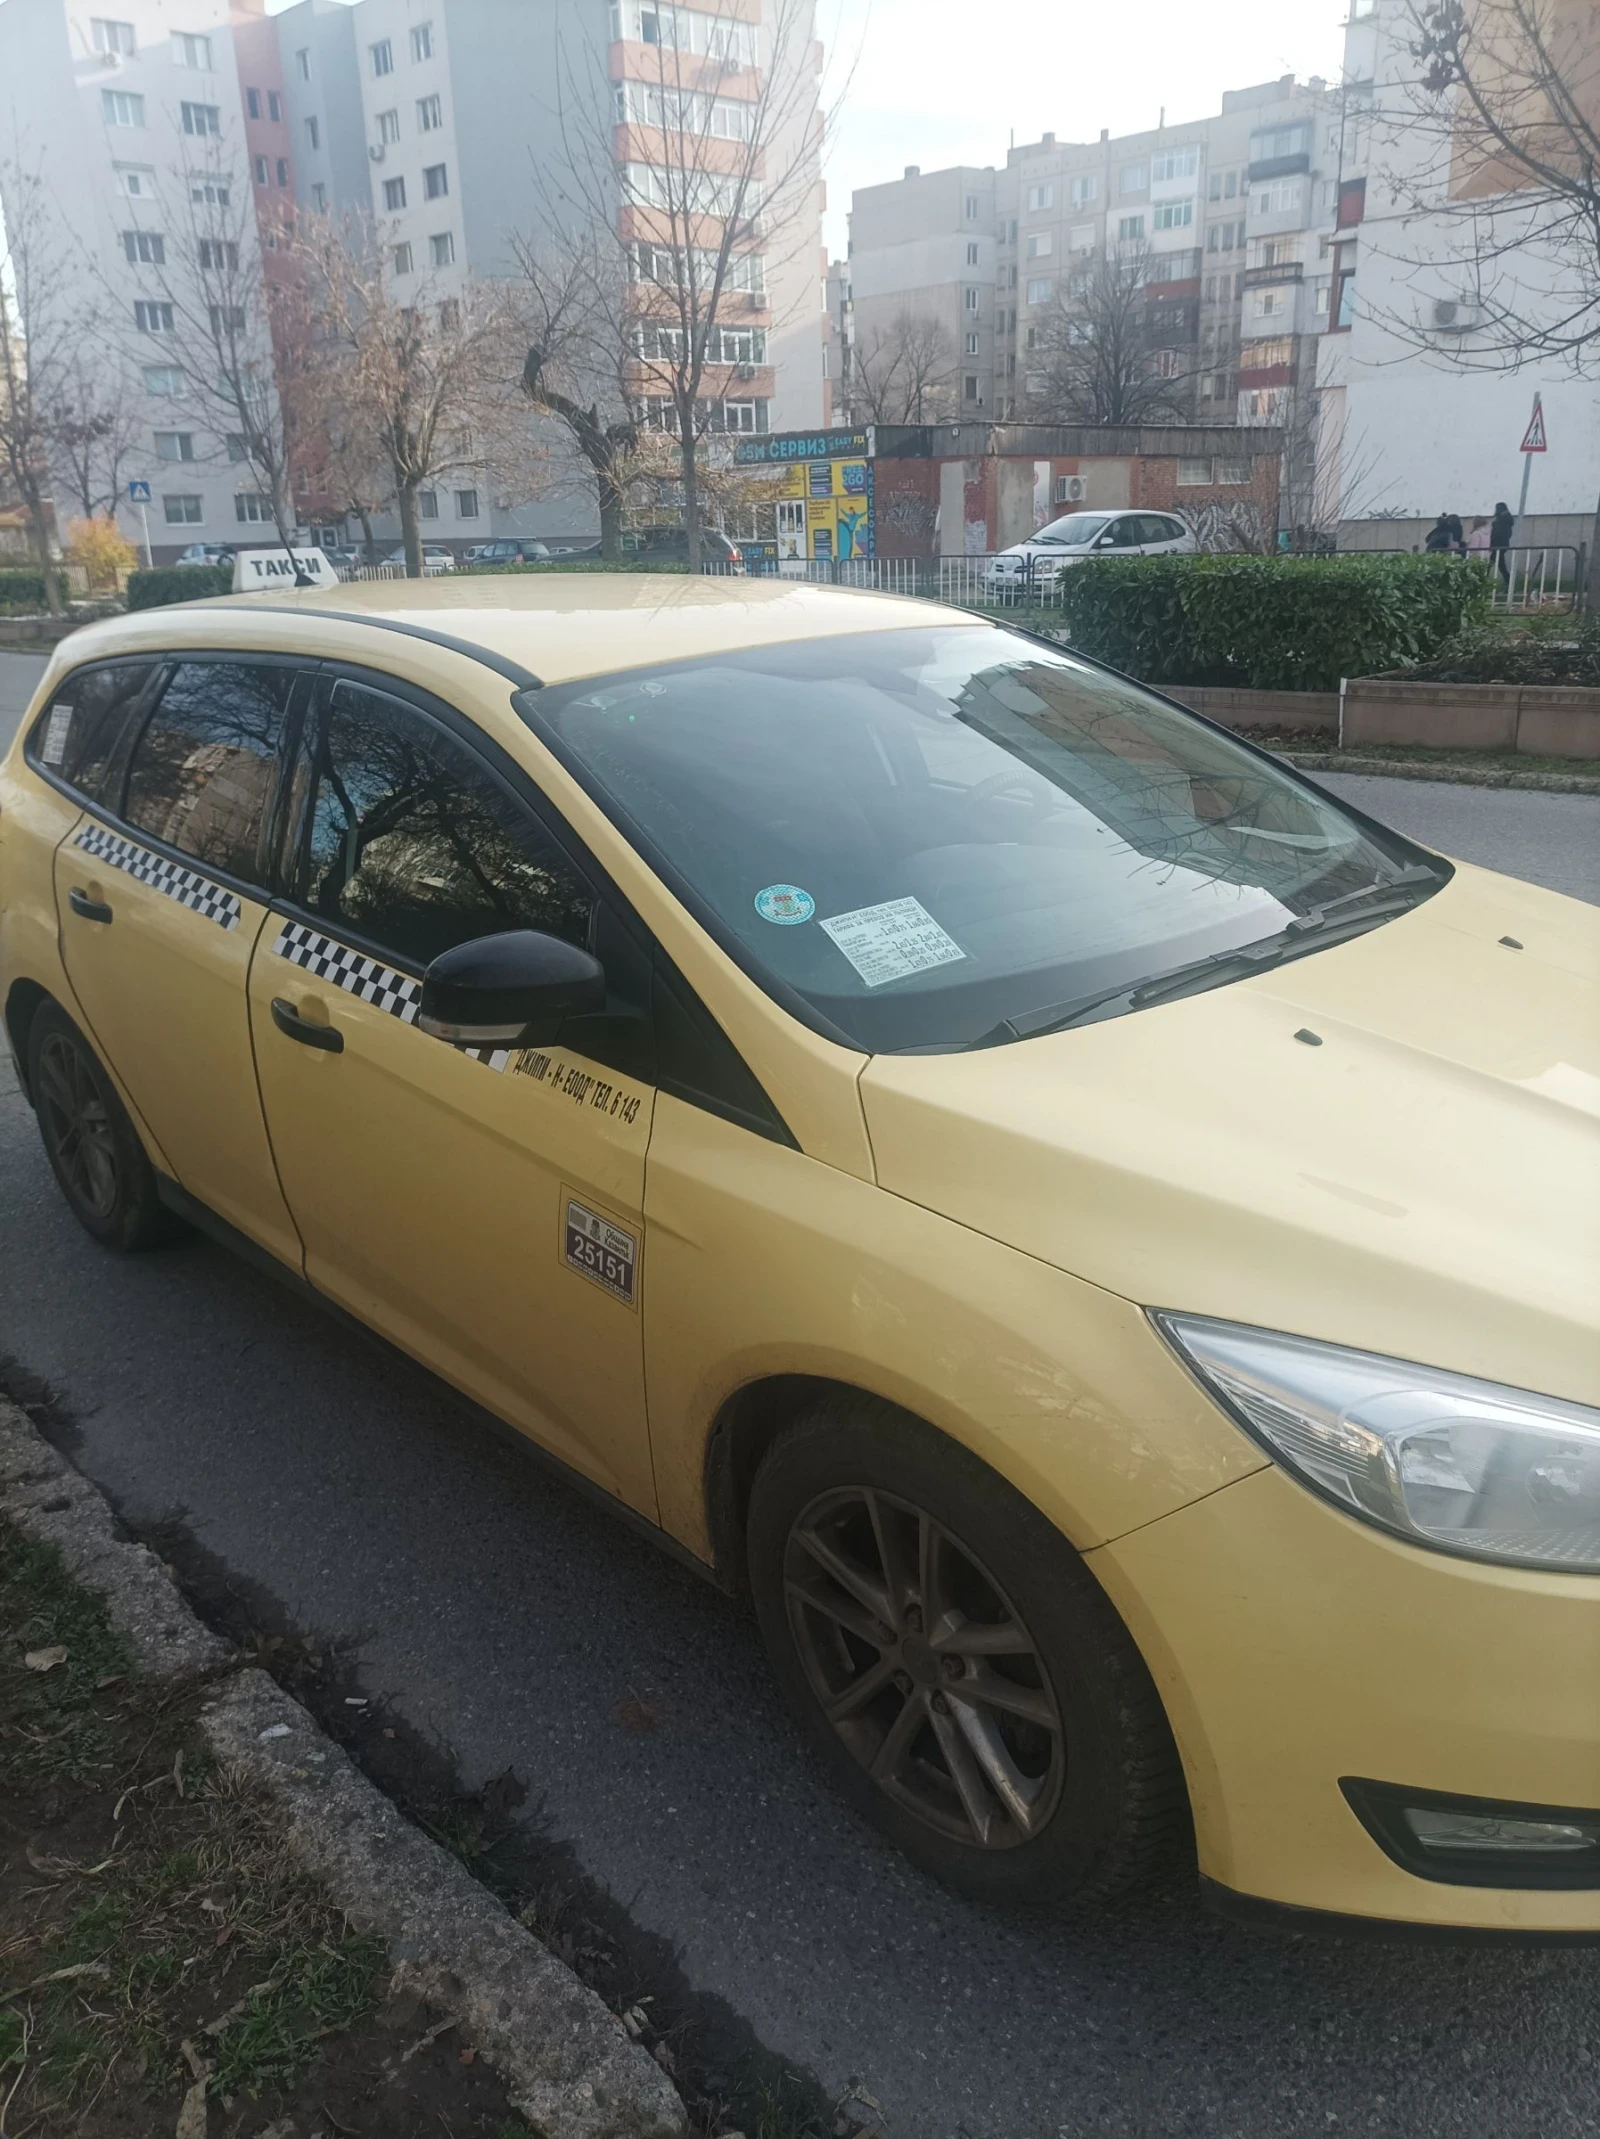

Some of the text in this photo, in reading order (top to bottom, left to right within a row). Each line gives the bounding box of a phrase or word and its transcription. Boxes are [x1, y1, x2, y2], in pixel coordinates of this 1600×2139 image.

[770, 437, 827, 458] СЕРВИЗ
[853, 435, 866, 444] FIX
[250, 557, 322, 577] ТАКСИ
[589, 1081, 609, 1112] ТЕЛ.
[573, 1235, 626, 1286] 25151
